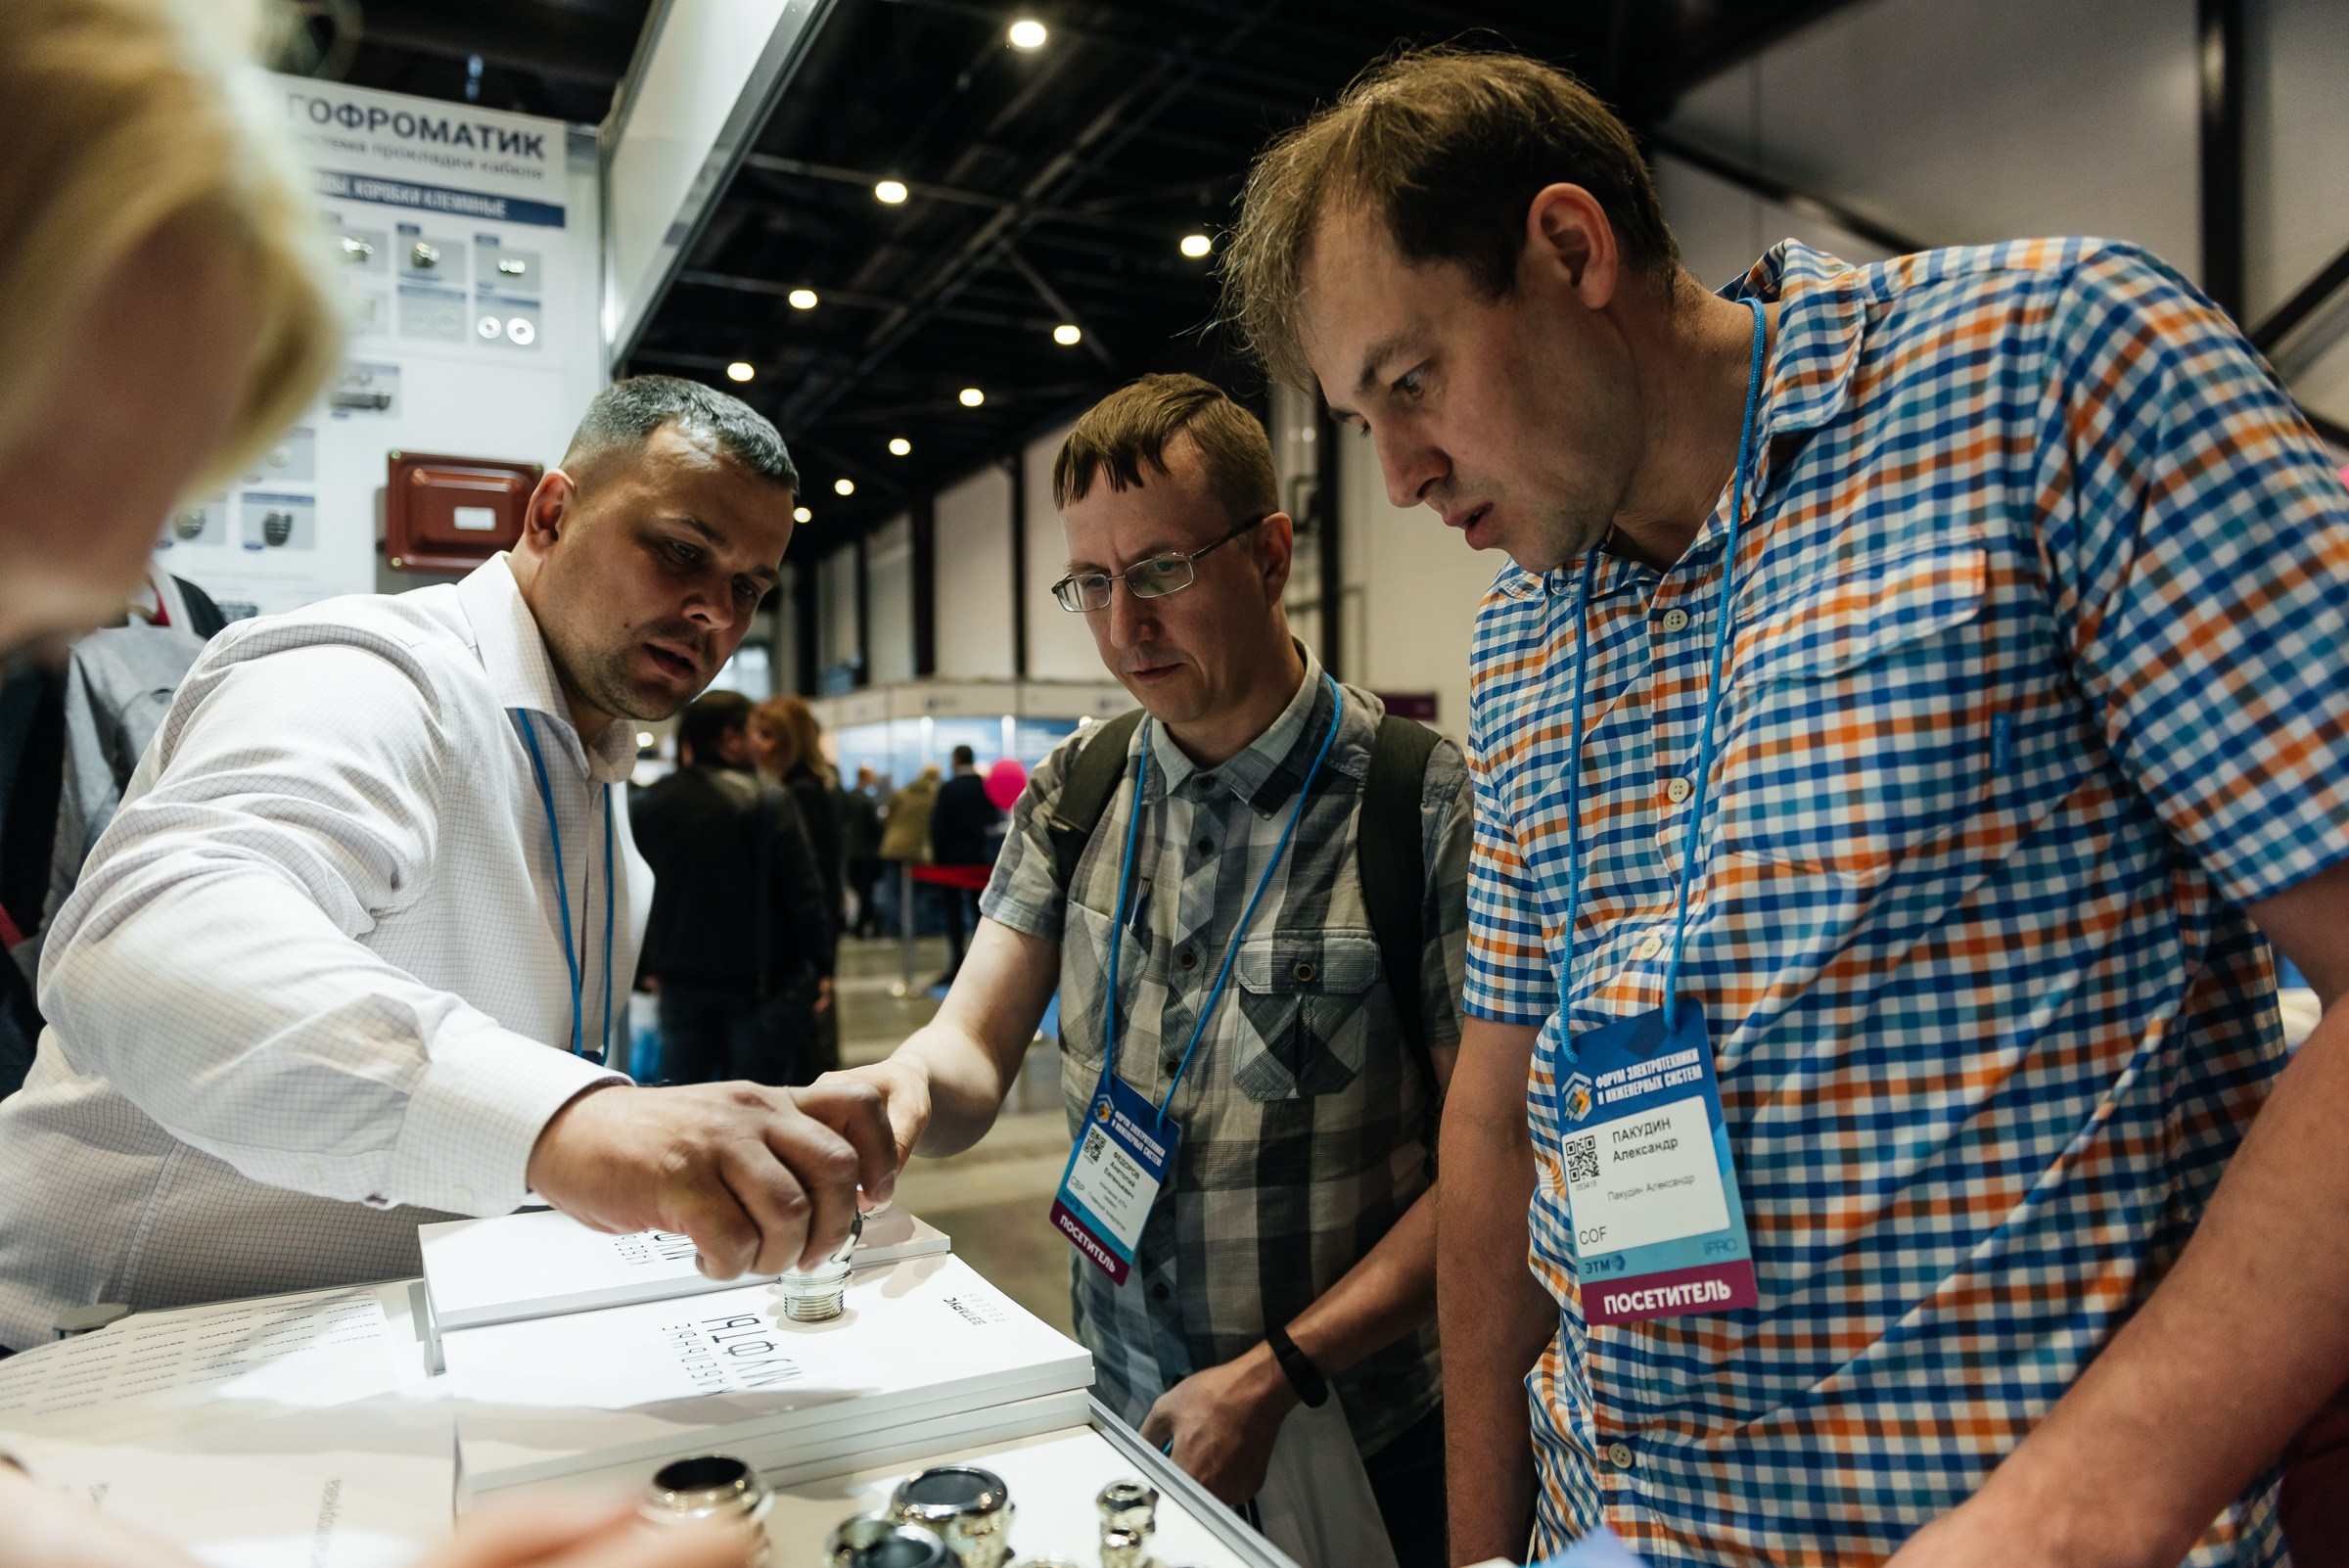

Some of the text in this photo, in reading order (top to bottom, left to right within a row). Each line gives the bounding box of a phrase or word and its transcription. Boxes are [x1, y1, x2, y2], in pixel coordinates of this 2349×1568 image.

[287, 92, 545, 162] ГОФРОМАТИК
[1594, 1068, 1627, 1089] ФОРУМ
[1664, 1064, 1703, 1087] СИСТЕМ
[1612, 1117, 1672, 1144] ПАКУДИН
[1613, 1136, 1680, 1163] Александр
[1113, 1151, 1140, 1180] ФЕДОРОВ
[1607, 1175, 1696, 1203] Пакудин Александр
[1059, 1214, 1116, 1273] ПОСЕТИТЕЛЬ
[1579, 1225, 1607, 1245] COF
[1585, 1259, 1611, 1274] ЭТМ
[1603, 1278, 1732, 1315] ПОСЕТИТЕЛЬ
[701, 1313, 806, 1389] МУФТЫ
